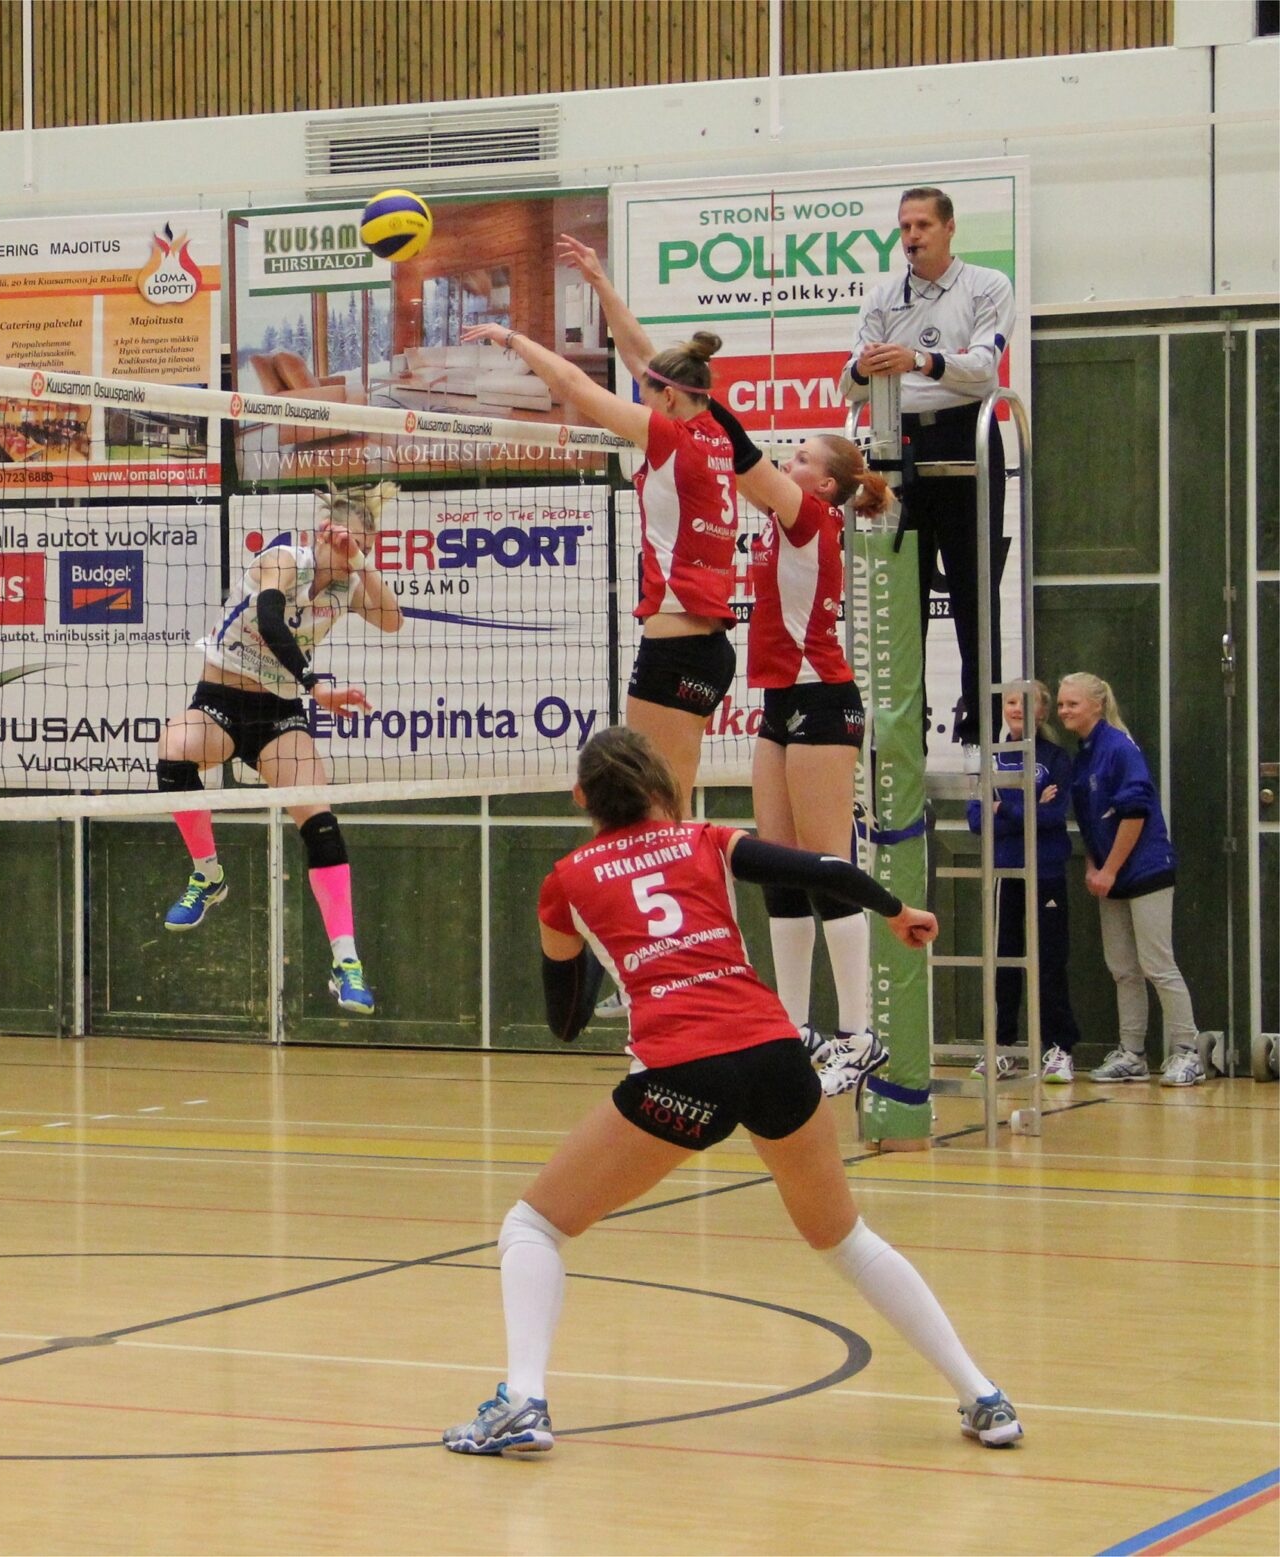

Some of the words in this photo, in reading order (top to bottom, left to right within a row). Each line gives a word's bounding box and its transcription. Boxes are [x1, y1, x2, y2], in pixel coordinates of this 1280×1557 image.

[699, 206, 785, 226] STRONG
[793, 201, 864, 220] WOOD
[50, 240, 120, 255] MAJOITUS
[264, 223, 360, 254] KUUSAM
[271, 254, 366, 273] HIRSITALOT
[23, 277, 36, 286] km
[154, 273, 187, 284] LOMA
[148, 284, 194, 296] LOPOTTI
[698, 283, 864, 307] www.polkky.fi
[0, 320, 41, 332] Catering
[42, 318, 83, 331] palvelut
[129, 315, 184, 328] Majoitusta
[46, 380, 91, 397] Kuusamon
[94, 382, 146, 403] Osuuspankki
[243, 400, 282, 417] Kuusamon
[284, 402, 330, 422] Osuuspankki
[416, 417, 451, 432] Kuusamon
[453, 420, 493, 437] Osuuspankki
[716, 474, 734, 525] 3
[436, 511, 477, 524] SPORT
[484, 511, 502, 521] TO
[509, 510, 534, 521] THE
[542, 509, 592, 521] PEOPLE
[37, 528, 98, 548] autot
[105, 523, 198, 547] vuokraa
[300, 526, 586, 570] ERSPORT
[72, 565, 132, 587] Budget
[384, 579, 470, 596] USAMO
[929, 601, 949, 616] 852
[114, 629, 125, 645] ja
[874, 558, 891, 709] HIRSITALOT
[309, 696, 518, 752] Europinta
[534, 696, 597, 751] Oy
[573, 827, 695, 864] Energiapolar
[593, 842, 693, 883] PEKKARINEN
[631, 872, 683, 937] 5
[643, 1090, 713, 1125] MONTE
[641, 1099, 702, 1139] ROSA
